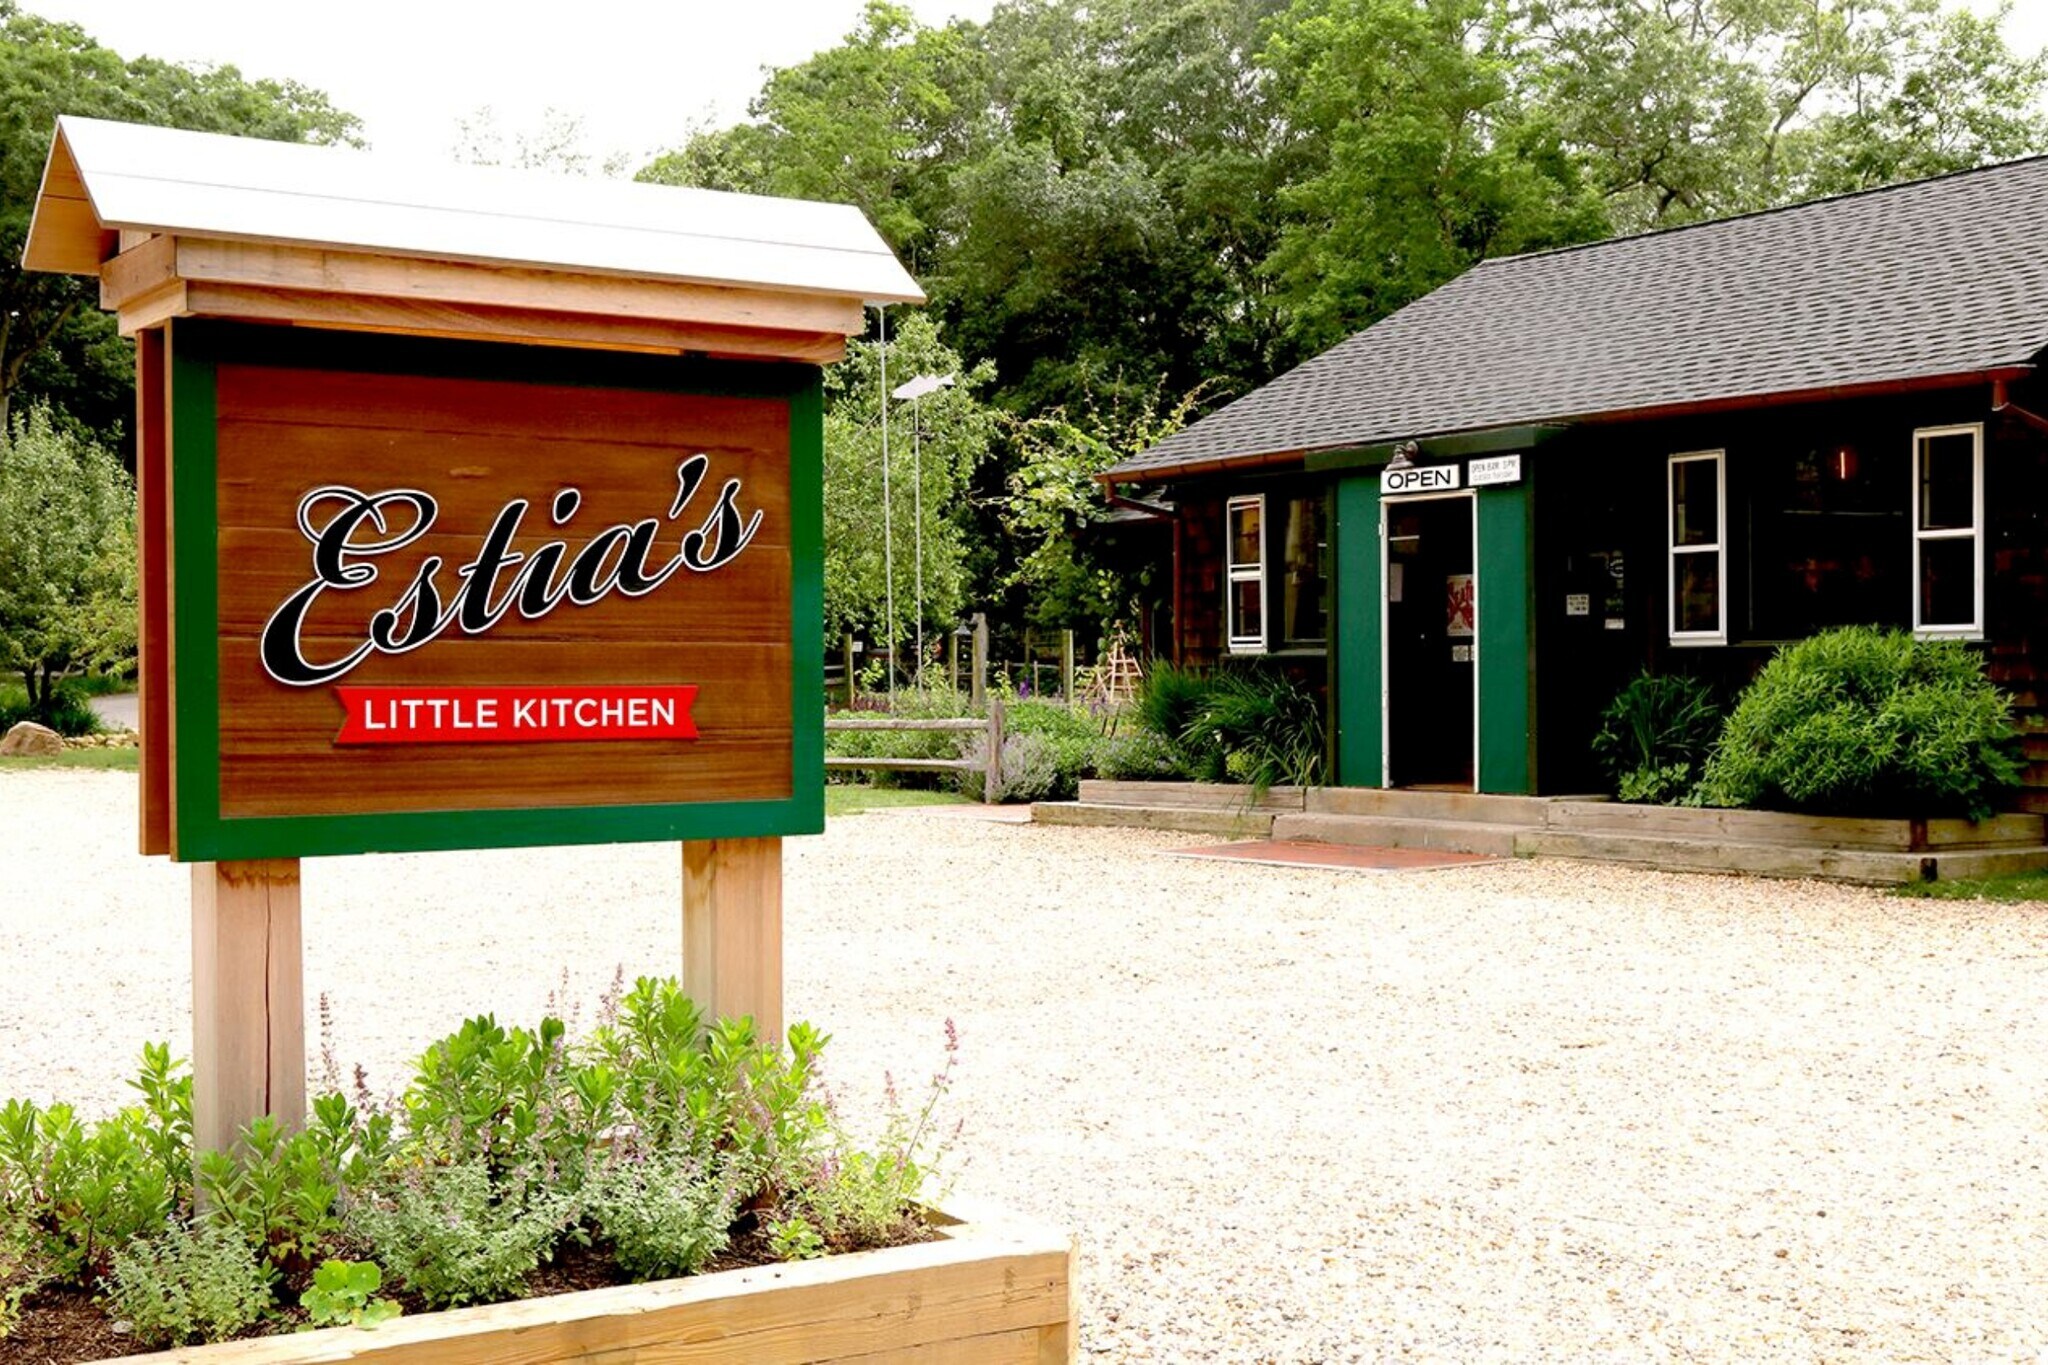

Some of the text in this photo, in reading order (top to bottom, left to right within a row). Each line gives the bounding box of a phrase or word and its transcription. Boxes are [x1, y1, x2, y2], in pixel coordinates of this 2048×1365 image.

[1388, 470, 1451, 489] OPEN
[260, 453, 763, 687] Estia's
[364, 697, 675, 729] LITTLE KITCHEN
